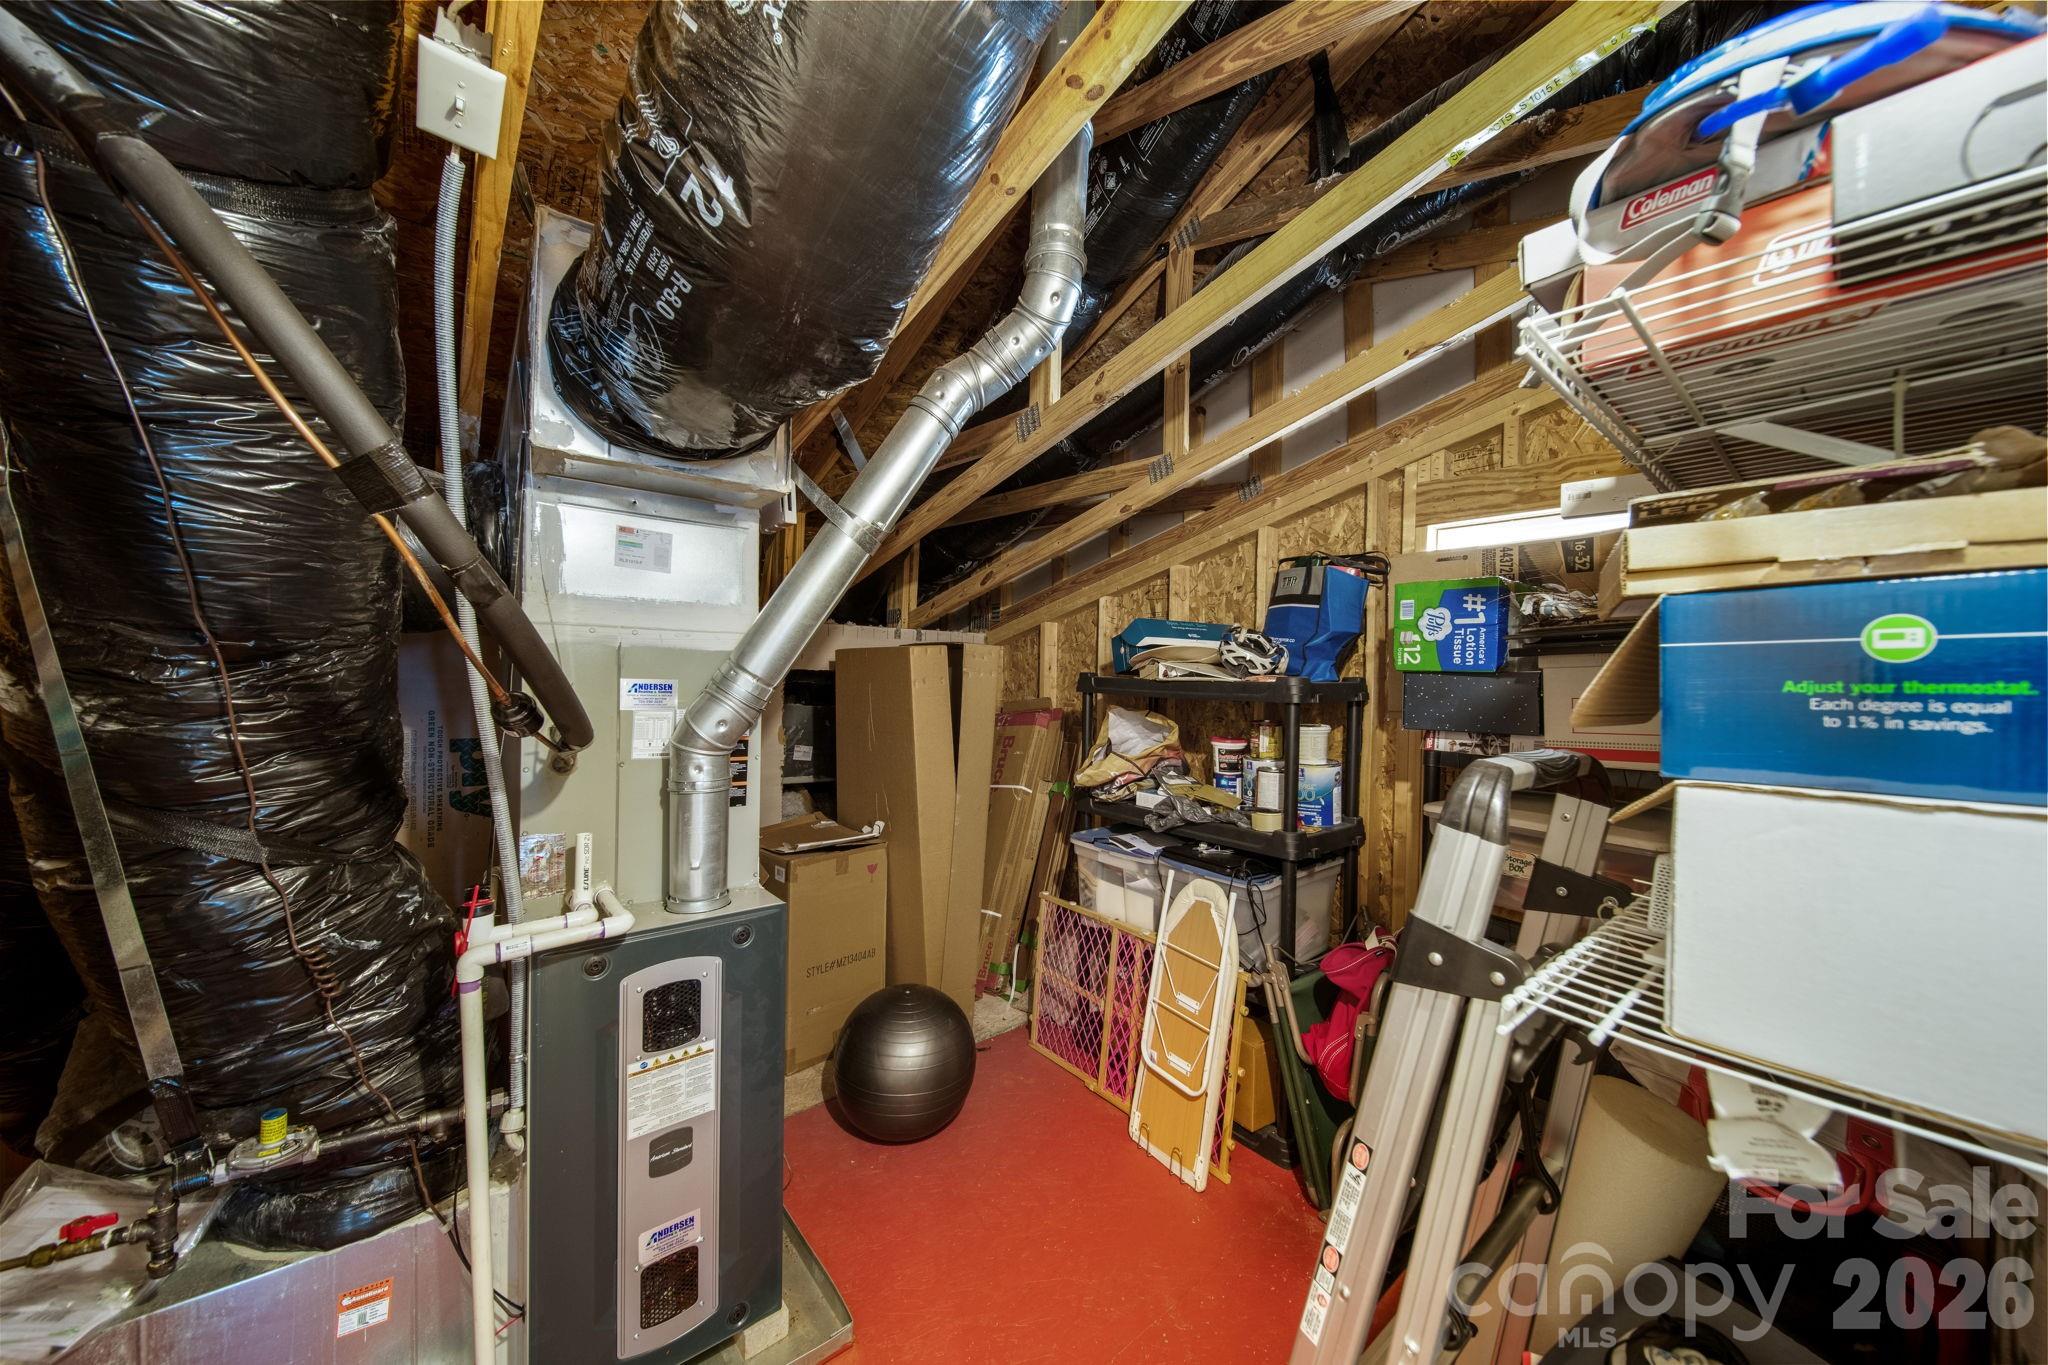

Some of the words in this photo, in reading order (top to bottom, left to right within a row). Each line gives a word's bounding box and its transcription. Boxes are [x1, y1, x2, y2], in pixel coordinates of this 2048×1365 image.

[1529, 84, 1554, 103] 1015
[1628, 174, 1714, 219] Coleman
[655, 270, 693, 321] R-8.0
[1574, 540, 1586, 551] 16
[1574, 554, 1591, 572] 32
[1454, 594, 1487, 625] #1
[1424, 611, 1447, 638] Puffs
[1403, 644, 1421, 665] 12
[1453, 628, 1465, 665] Tissue
[1465, 628, 1477, 666] Lotion
[1478, 627, 1487, 665] America's
[627, 683, 673, 693] ANDERSEN
[1782, 680, 1845, 697] Adjust
[1849, 682, 1898, 697] your
[1902, 679, 2041, 696] thermostat.
[1809, 698, 1854, 711] Each
[1857, 700, 1924, 715] degree
[1928, 699, 1948, 713] is
[1950, 700, 2014, 716] equal
[428, 710, 436, 738] GREEN
[1822, 716, 1842, 728] to
[1847, 715, 1880, 729] 1%
[1884, 716, 1905, 730] in
[1907, 717, 1995, 736] savings.
[428, 742, 436, 817] NON-STRUCTURAL
[428, 819, 436, 848] GRADE
[977, 941, 994, 980] Bruce
